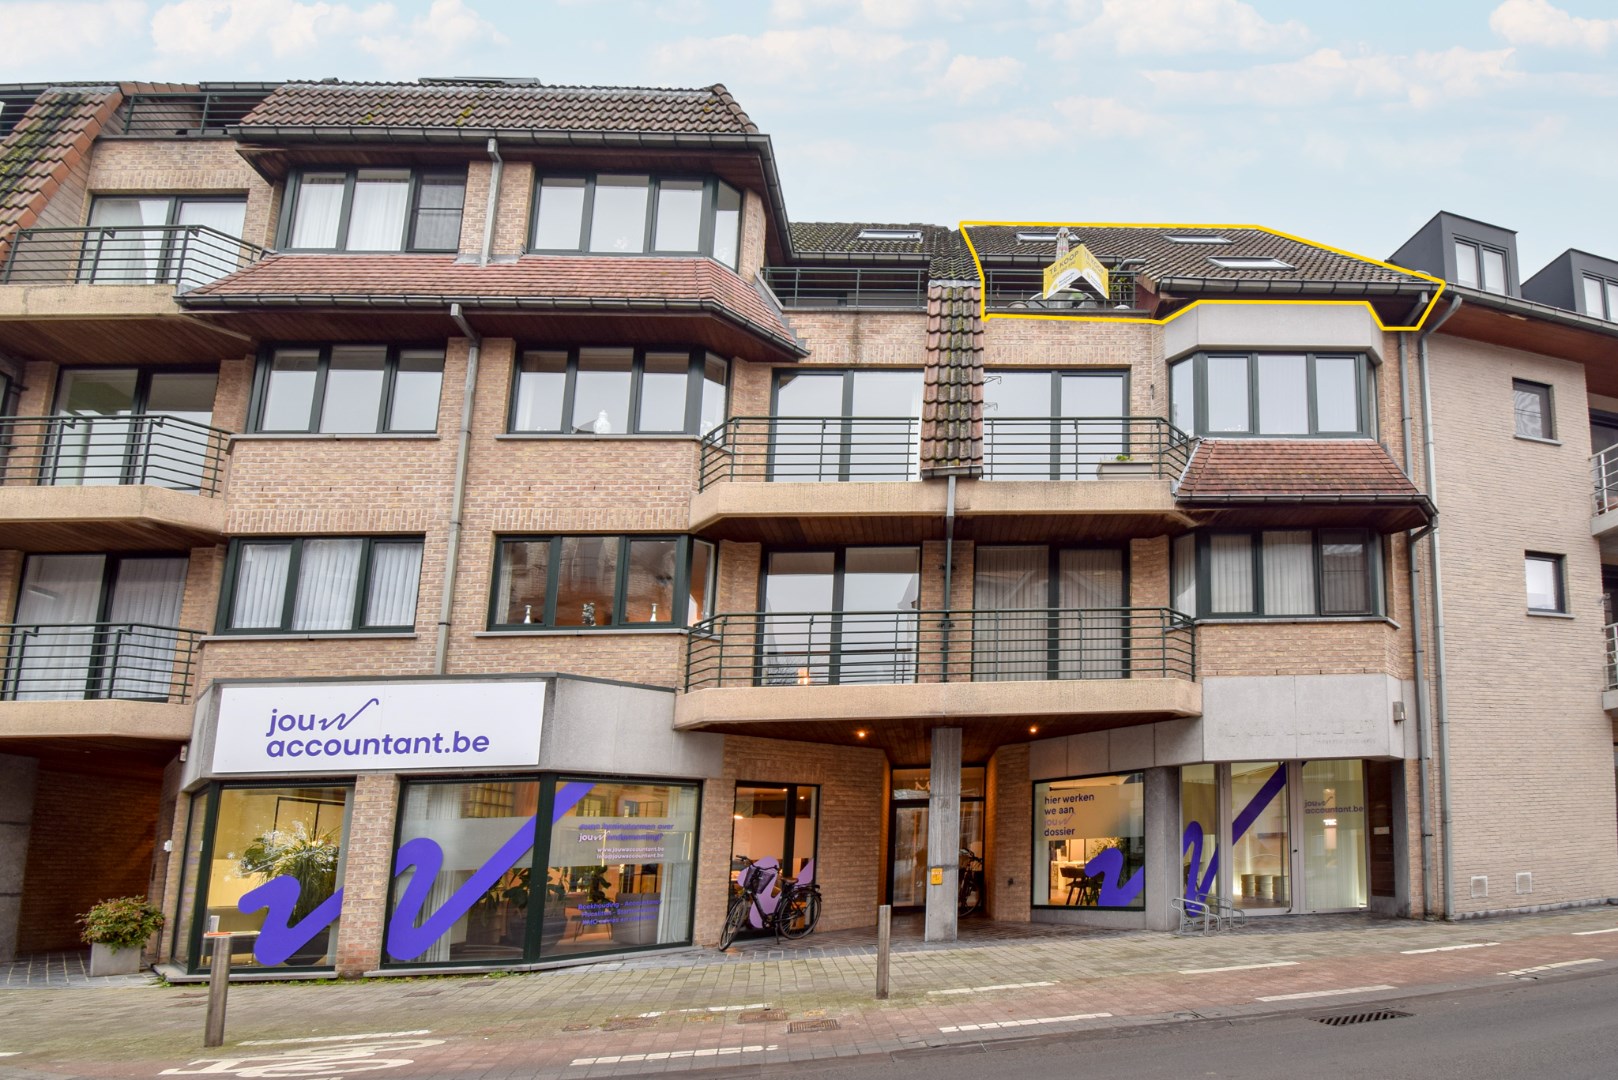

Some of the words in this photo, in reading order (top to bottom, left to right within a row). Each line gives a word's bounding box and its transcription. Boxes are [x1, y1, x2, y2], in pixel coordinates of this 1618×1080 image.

[265, 698, 380, 737] jouw
[266, 731, 490, 758] accountant.be
[1044, 795, 1061, 805] hier
[1062, 793, 1095, 803] werken
[1044, 807, 1057, 815] we
[1058, 806, 1074, 815] aan
[1305, 806, 1364, 814] accountant.be
[1044, 826, 1075, 837] dossier
[578, 902, 620, 910] Boekhouding
